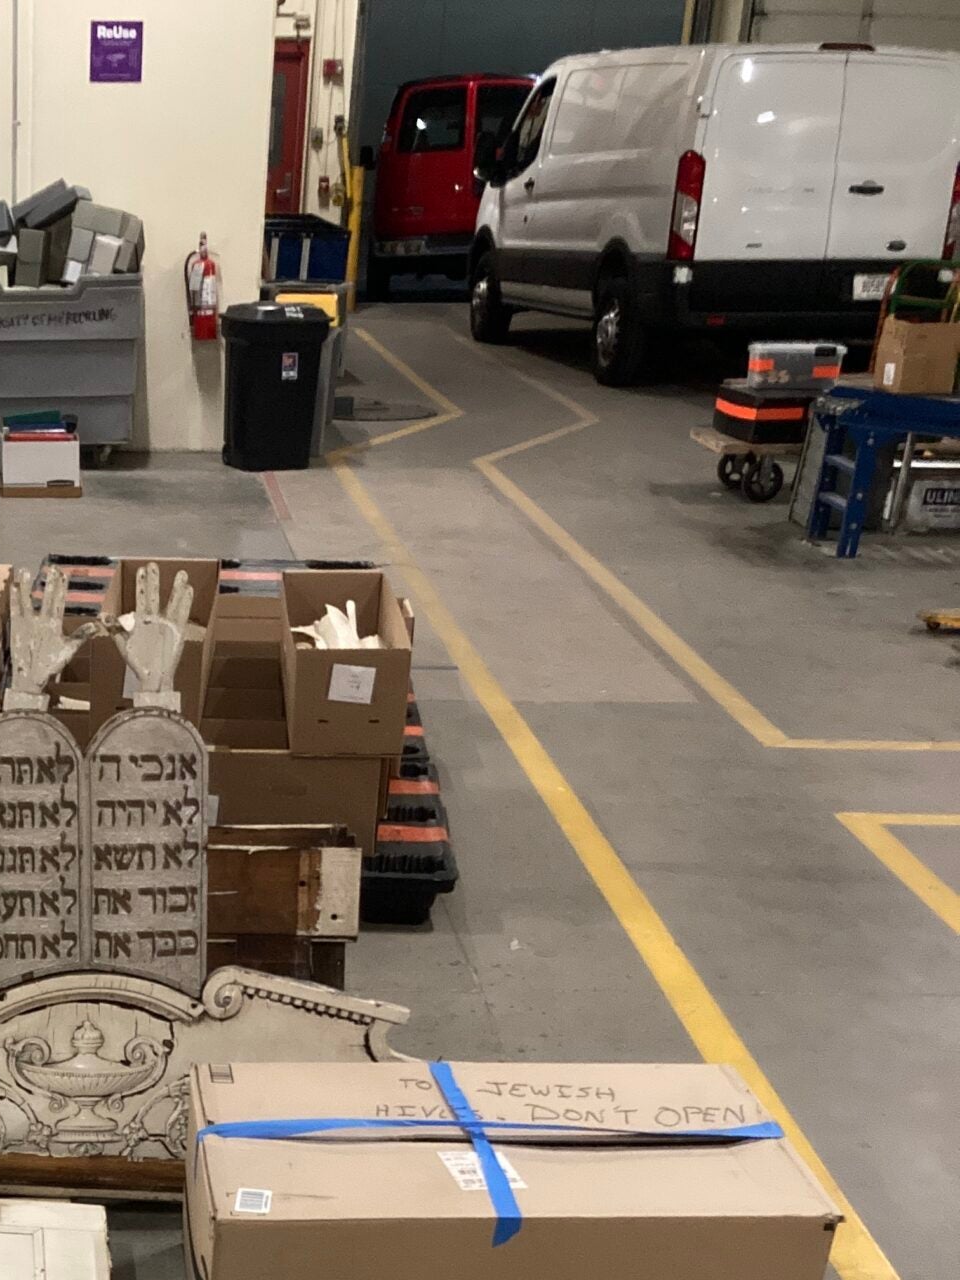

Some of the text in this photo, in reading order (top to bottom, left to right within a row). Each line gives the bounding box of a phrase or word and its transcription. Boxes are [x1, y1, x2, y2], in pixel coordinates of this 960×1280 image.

[96, 24, 137, 40] ReUse
[926, 490, 960, 504] ULIN
[96, 784, 200, 827] לא יהיה
[93, 828, 200, 871] לא תשא
[93, 886, 199, 915] זכור את
[94, 929, 132, 960] את
[397, 1078, 617, 1103] TO JEWISH
[523, 1103, 640, 1125] DON'T
[653, 1104, 747, 1128] OPEN
